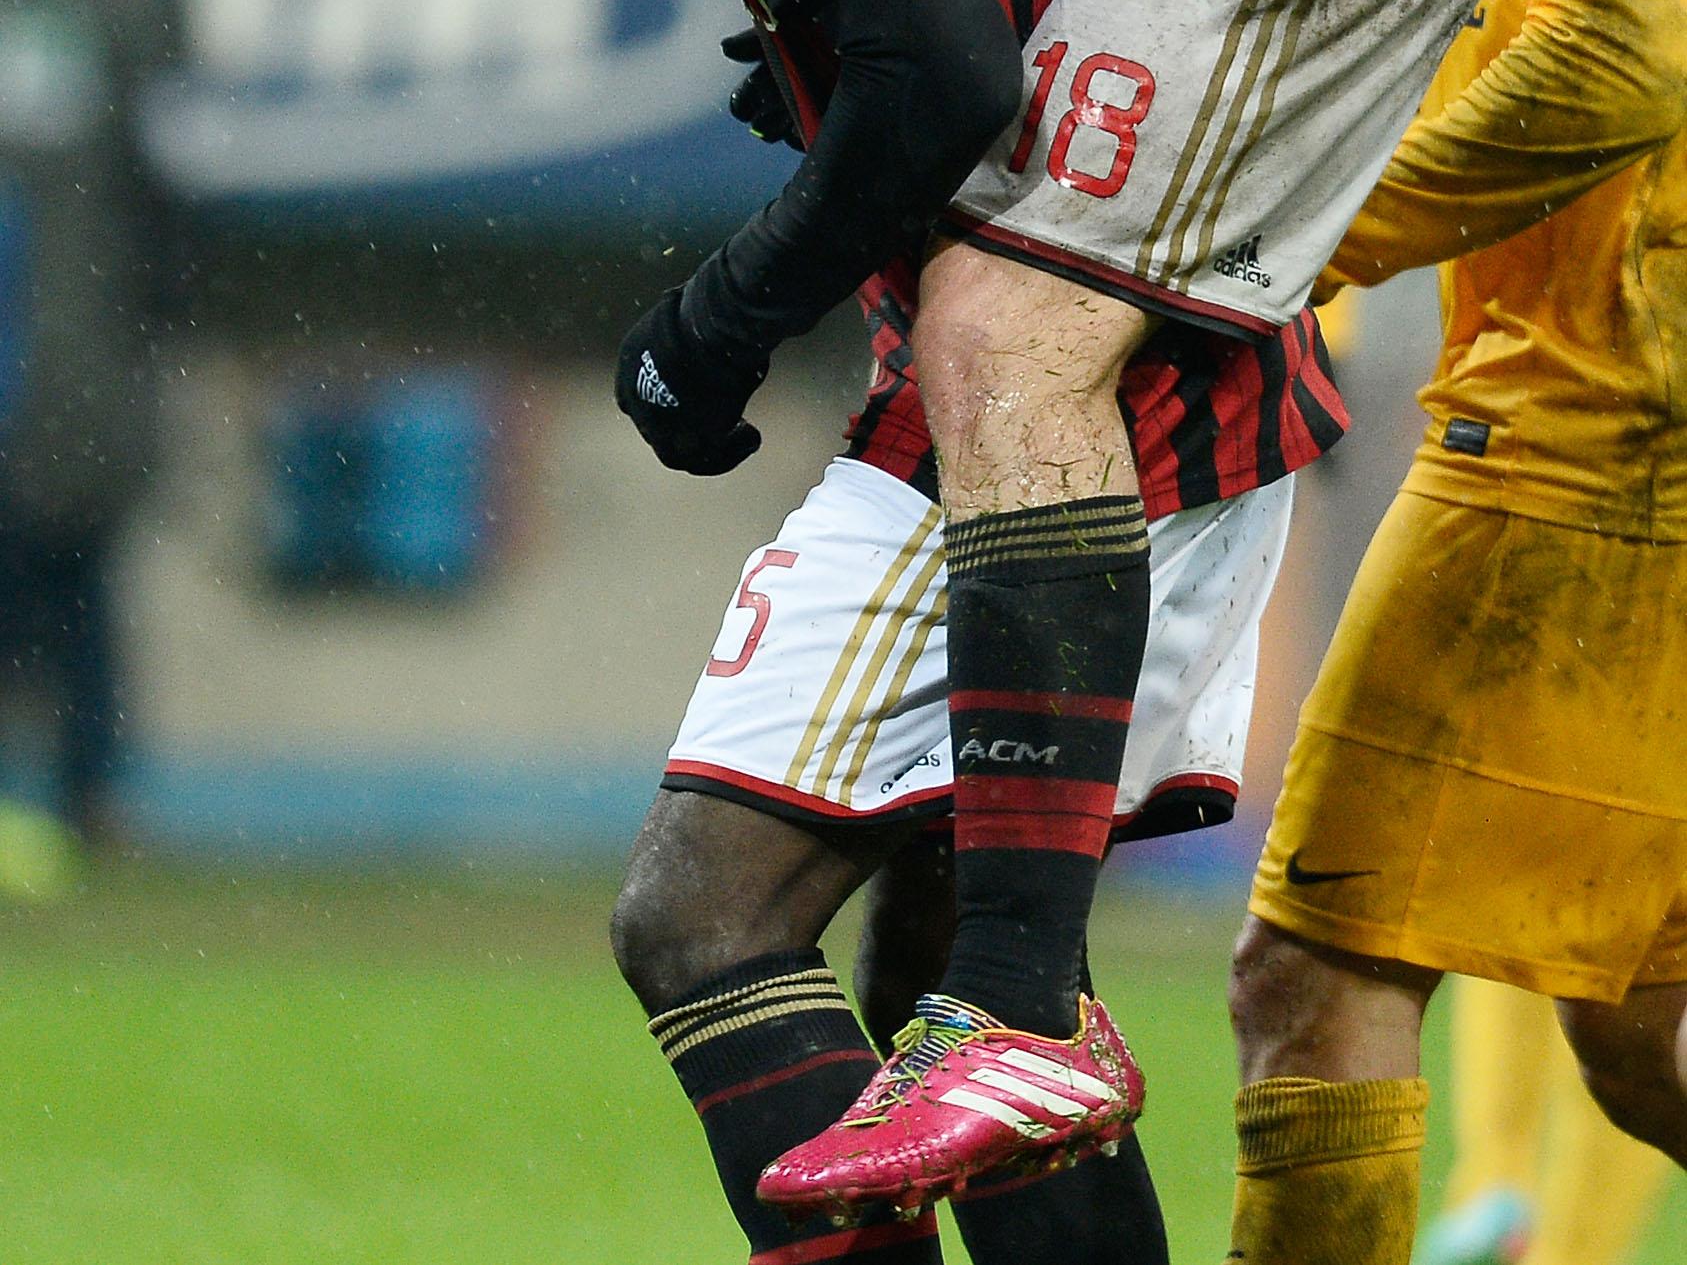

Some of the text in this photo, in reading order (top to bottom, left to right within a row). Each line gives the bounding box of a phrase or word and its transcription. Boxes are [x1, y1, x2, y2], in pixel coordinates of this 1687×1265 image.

[1008, 40, 1157, 199] 18
[1213, 257, 1272, 288] adidas
[706, 549, 800, 677] 5
[958, 738, 1060, 765] ACM
